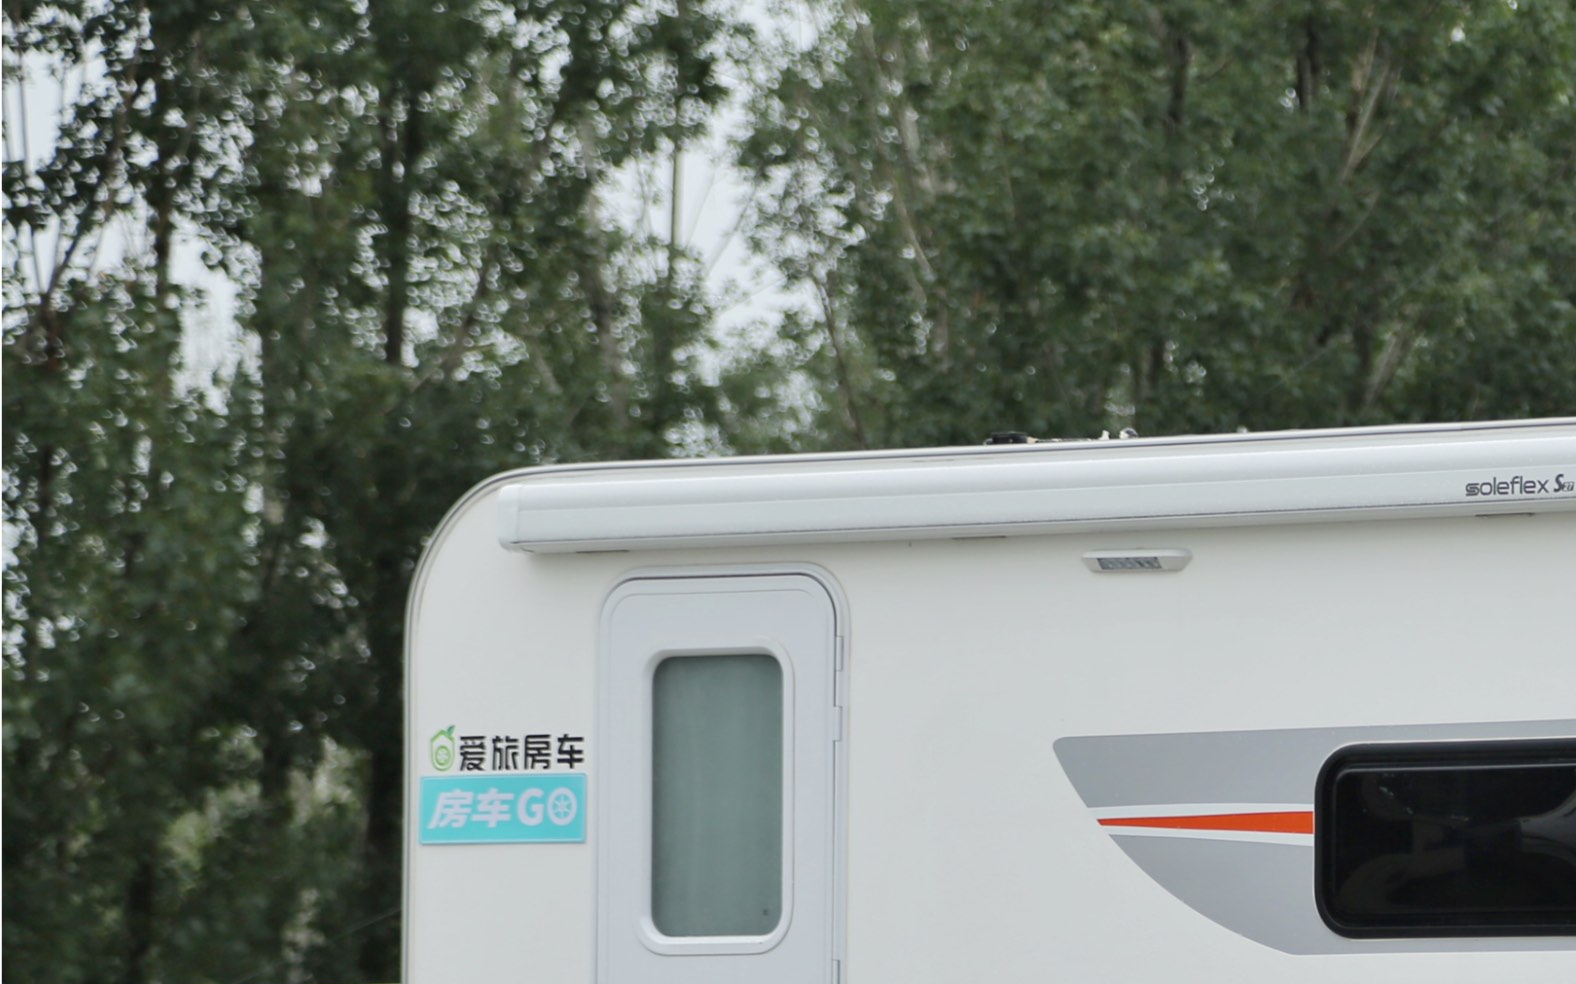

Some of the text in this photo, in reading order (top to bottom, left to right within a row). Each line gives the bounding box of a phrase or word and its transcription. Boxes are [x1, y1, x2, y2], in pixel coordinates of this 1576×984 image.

[1465, 476, 1550, 496] soleflex
[459, 734, 584, 771] 爱旅房车
